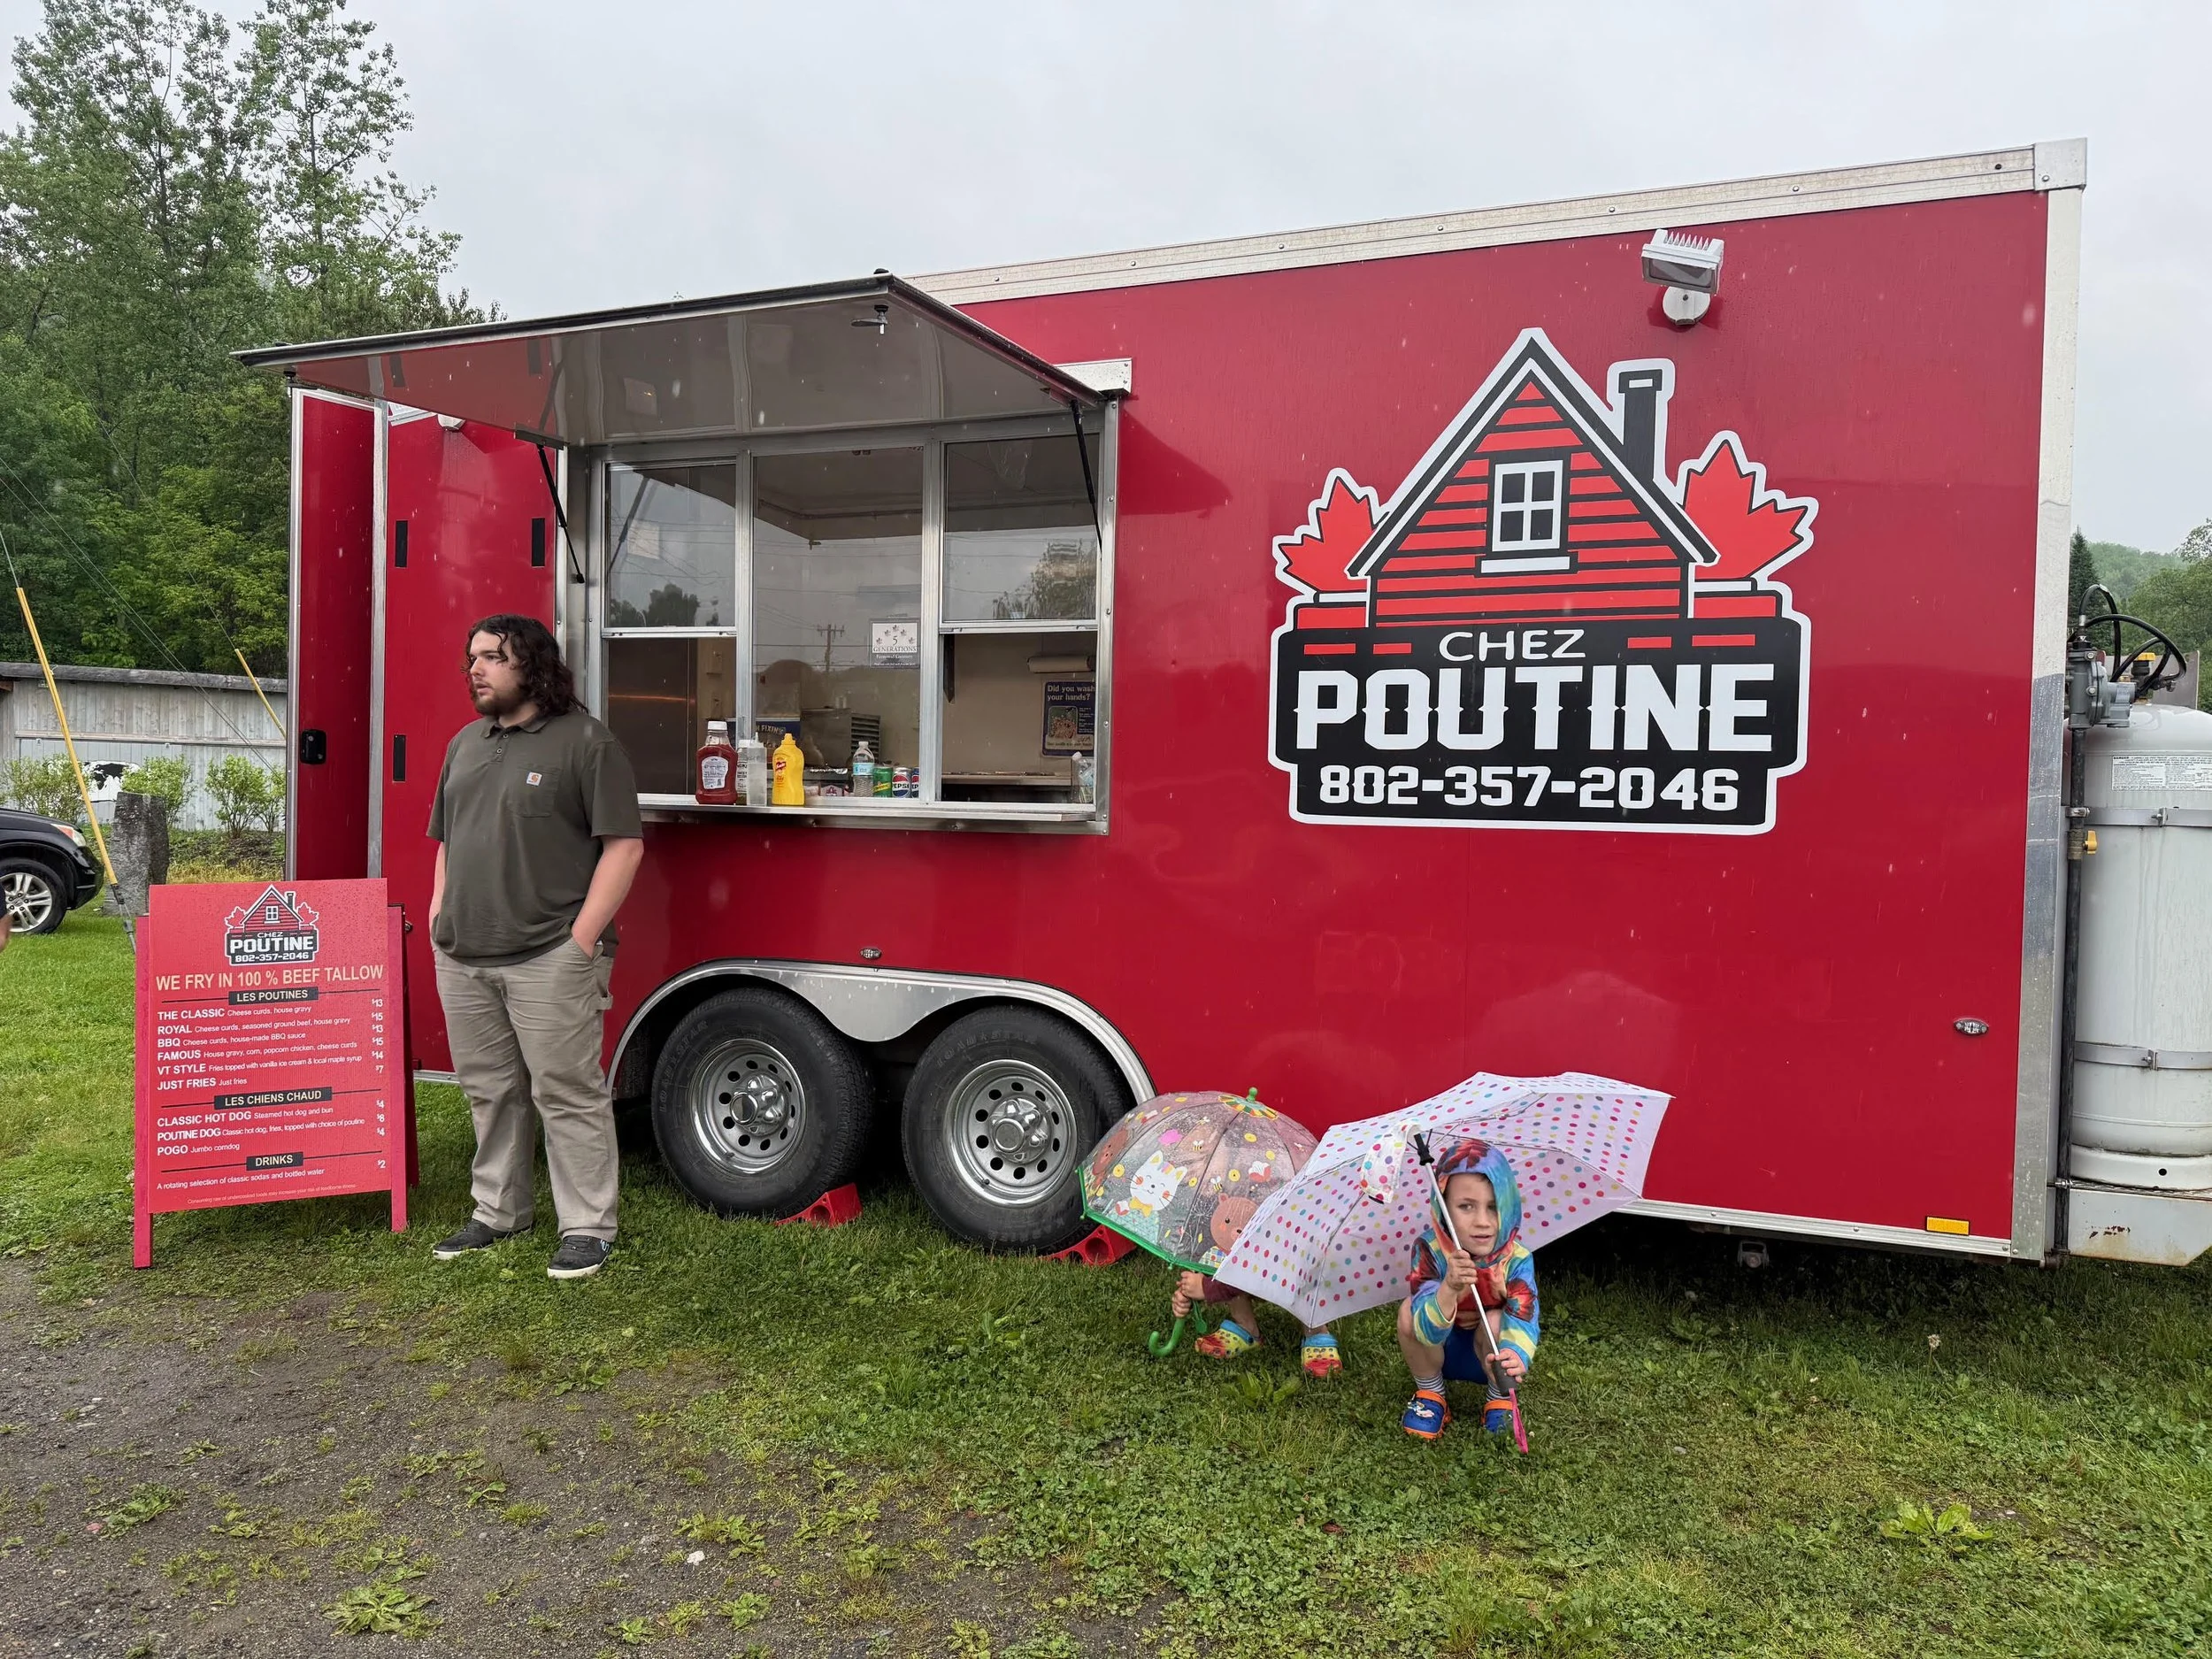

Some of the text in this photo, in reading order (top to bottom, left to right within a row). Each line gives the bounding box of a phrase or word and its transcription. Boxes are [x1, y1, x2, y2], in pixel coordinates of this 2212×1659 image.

[893, 635, 898, 646] 5
[1438, 629, 1586, 662] CHEZ
[1294, 664, 1774, 752] POUTINE
[1319, 764, 1739, 810] 802-357-2046
[230, 936, 314, 954] POUTINE
[234, 951, 310, 963] 802-357-2046
[156, 964, 384, 991] WE FRY IN 100 % BEEF TALLOW
[236, 989, 309, 1002] LES POUTINES
[157, 1011, 179, 1020] THE
[180, 1008, 226, 1019] CLASSIC
[294, 1005, 311, 1014] gravy
[372, 998, 384, 1008] $13
[157, 1025, 193, 1034] ROYAL
[273, 1020, 296, 1029] ground
[372, 1011, 384, 1021] $15
[157, 1038, 180, 1048] BBQ
[230, 1034, 269, 1044] house-made
[157, 1049, 202, 1061] FAMOUS
[264, 1046, 289, 1055] popcorn
[157, 1065, 172, 1076] VT
[173, 1064, 207, 1074] STYLE
[346, 1054, 363, 1063] syrup
[372, 1050, 384, 1060] $14
[157, 1079, 185, 1090] JUST
[186, 1077, 218, 1088] FRIES
[375, 1064, 384, 1074] $7
[225, 1090, 322, 1107] LES CHIENS CHAUD
[157, 1116, 203, 1127] CLASSIC
[204, 1112, 227, 1124] HOT
[228, 1110, 252, 1122] DOG
[254, 1110, 282, 1119] Steamed
[295, 1109, 307, 1118] dog
[376, 1099, 385, 1110] $4
[157, 1129, 199, 1142] POUTINE
[199, 1127, 221, 1139] DOG
[222, 1127, 244, 1136] Classic
[284, 1123, 305, 1132] topped
[344, 1118, 365, 1127] poutine
[377, 1113, 385, 1123] $8
[157, 1145, 188, 1156] POGO
[213, 1143, 240, 1152] corndog
[376, 1127, 386, 1137] $4
[255, 1155, 294, 1167] DRINKS
[163, 1180, 188, 1189] rotating
[189, 1177, 219, 1187] selection
[227, 1175, 250, 1184] classic
[250, 1172, 270, 1181] sodas
[377, 1159, 386, 1169] $2
